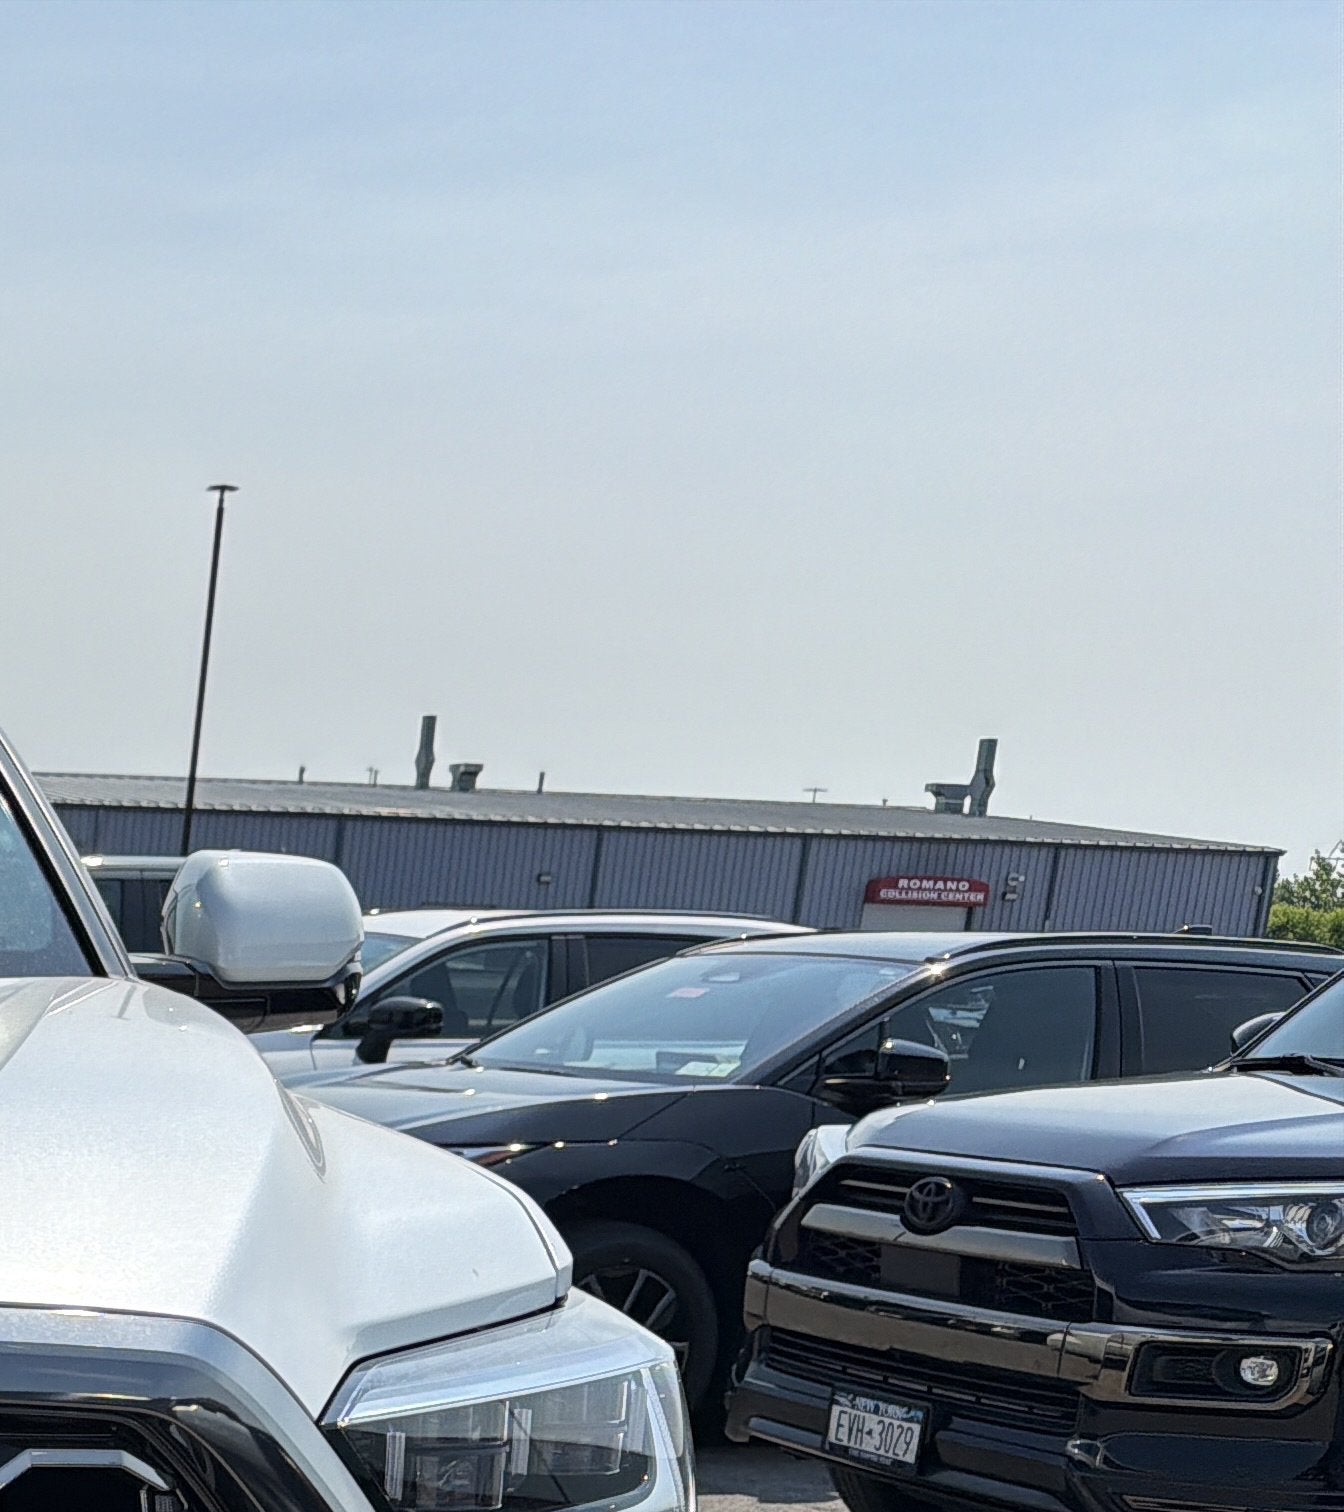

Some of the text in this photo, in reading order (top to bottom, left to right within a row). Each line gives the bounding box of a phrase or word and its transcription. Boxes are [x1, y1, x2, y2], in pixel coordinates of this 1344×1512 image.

[898, 878, 970, 891] ROMANO
[879, 888, 985, 902] COLLISION CENTER
